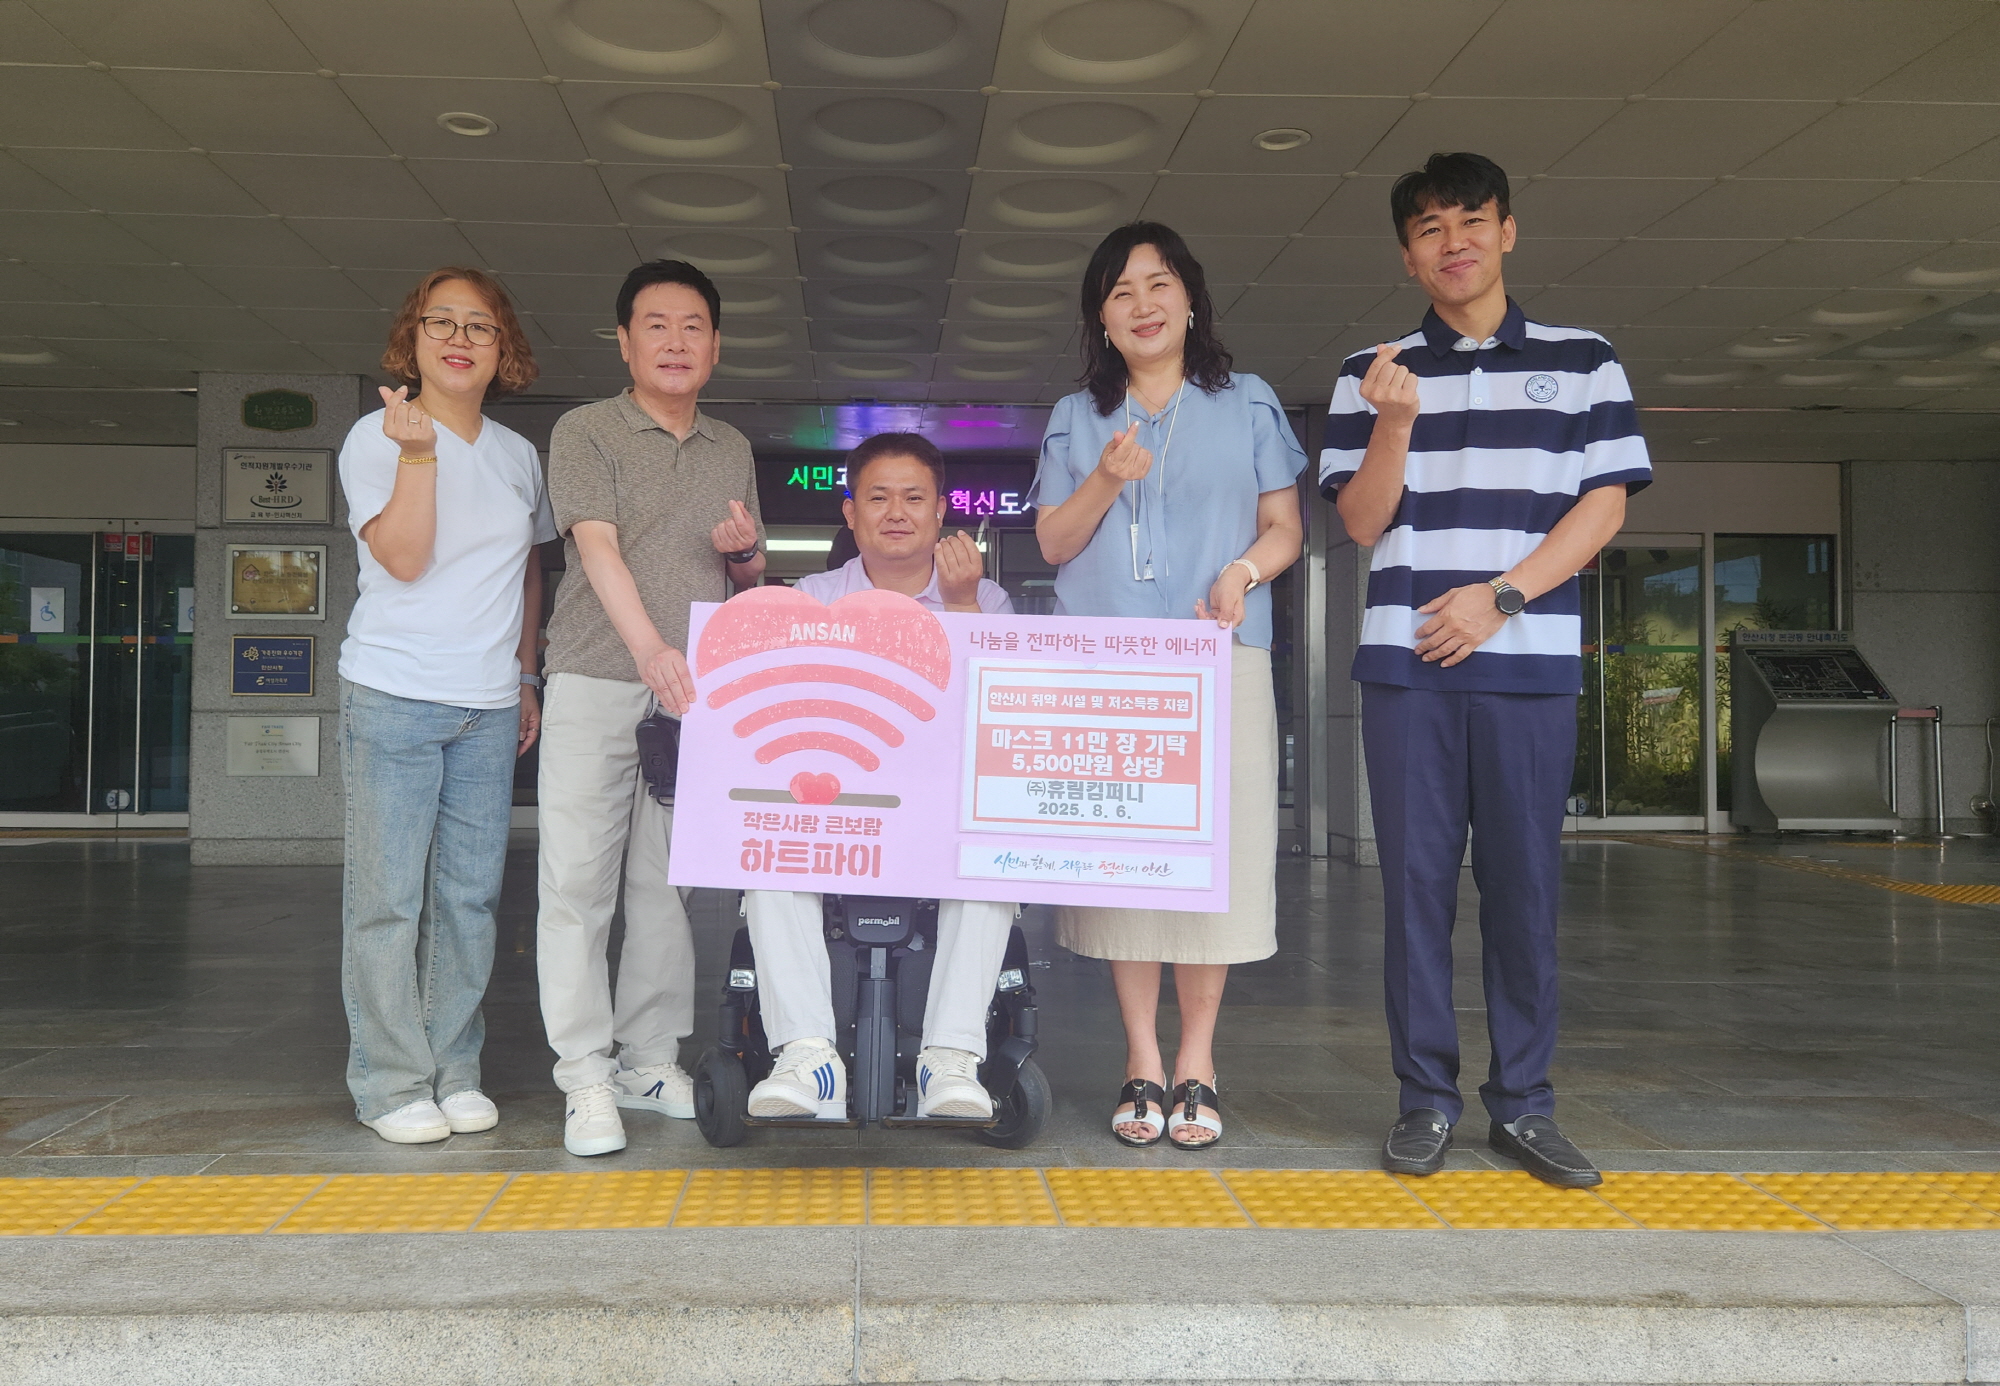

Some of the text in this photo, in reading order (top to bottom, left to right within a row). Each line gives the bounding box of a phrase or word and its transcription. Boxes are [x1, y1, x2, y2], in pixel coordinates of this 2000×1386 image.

[949, 490, 1031, 515] 혁신도
[789, 622, 856, 643] ANSAN
[970, 631, 1217, 656] 나눔을 전파하는 따뜻한 에너지
[990, 692, 1189, 712] 안산시 취약 시설 및 저소득층 지원
[992, 729, 1187, 756] 마스크 11만 장 기탁
[1012, 753, 1164, 778] 5,500만원 상당
[1038, 802, 1132, 819] 2025. 8. 6.
[744, 812, 882, 836] 작은사랑 큰보람
[740, 838, 882, 878] 하트파이
[994, 851, 1030, 873] 시민과
[1059, 859, 1094, 878] 자유로운
[1098, 860, 1138, 878] 혁신도시
[1142, 862, 1174, 877] 안산
[858, 916, 900, 927] permobil
